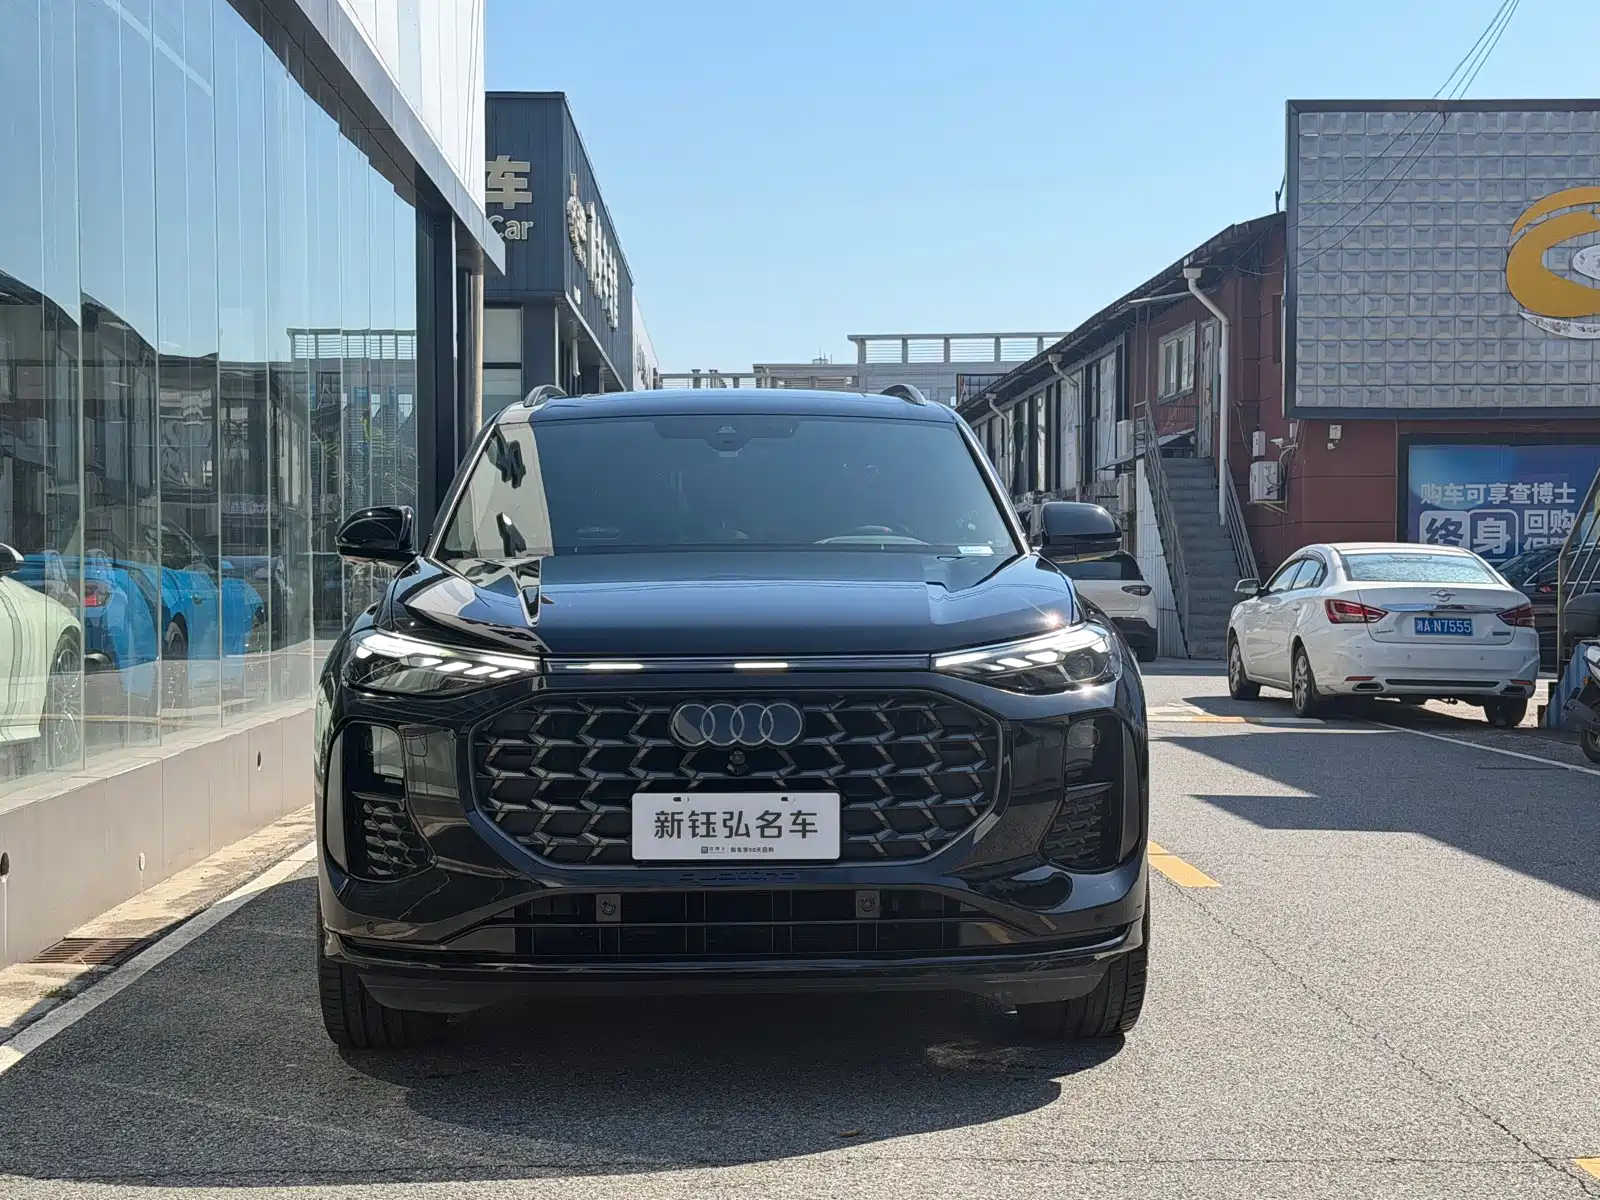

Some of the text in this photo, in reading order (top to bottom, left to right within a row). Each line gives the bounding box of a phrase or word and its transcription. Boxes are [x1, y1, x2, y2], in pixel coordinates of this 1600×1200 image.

[485, 154, 533, 210] 车
[1420, 482, 1577, 505] 购车可享查博士
[1425, 517, 1511, 555] 终身
[653, 809, 818, 840] 新钰弘名车
